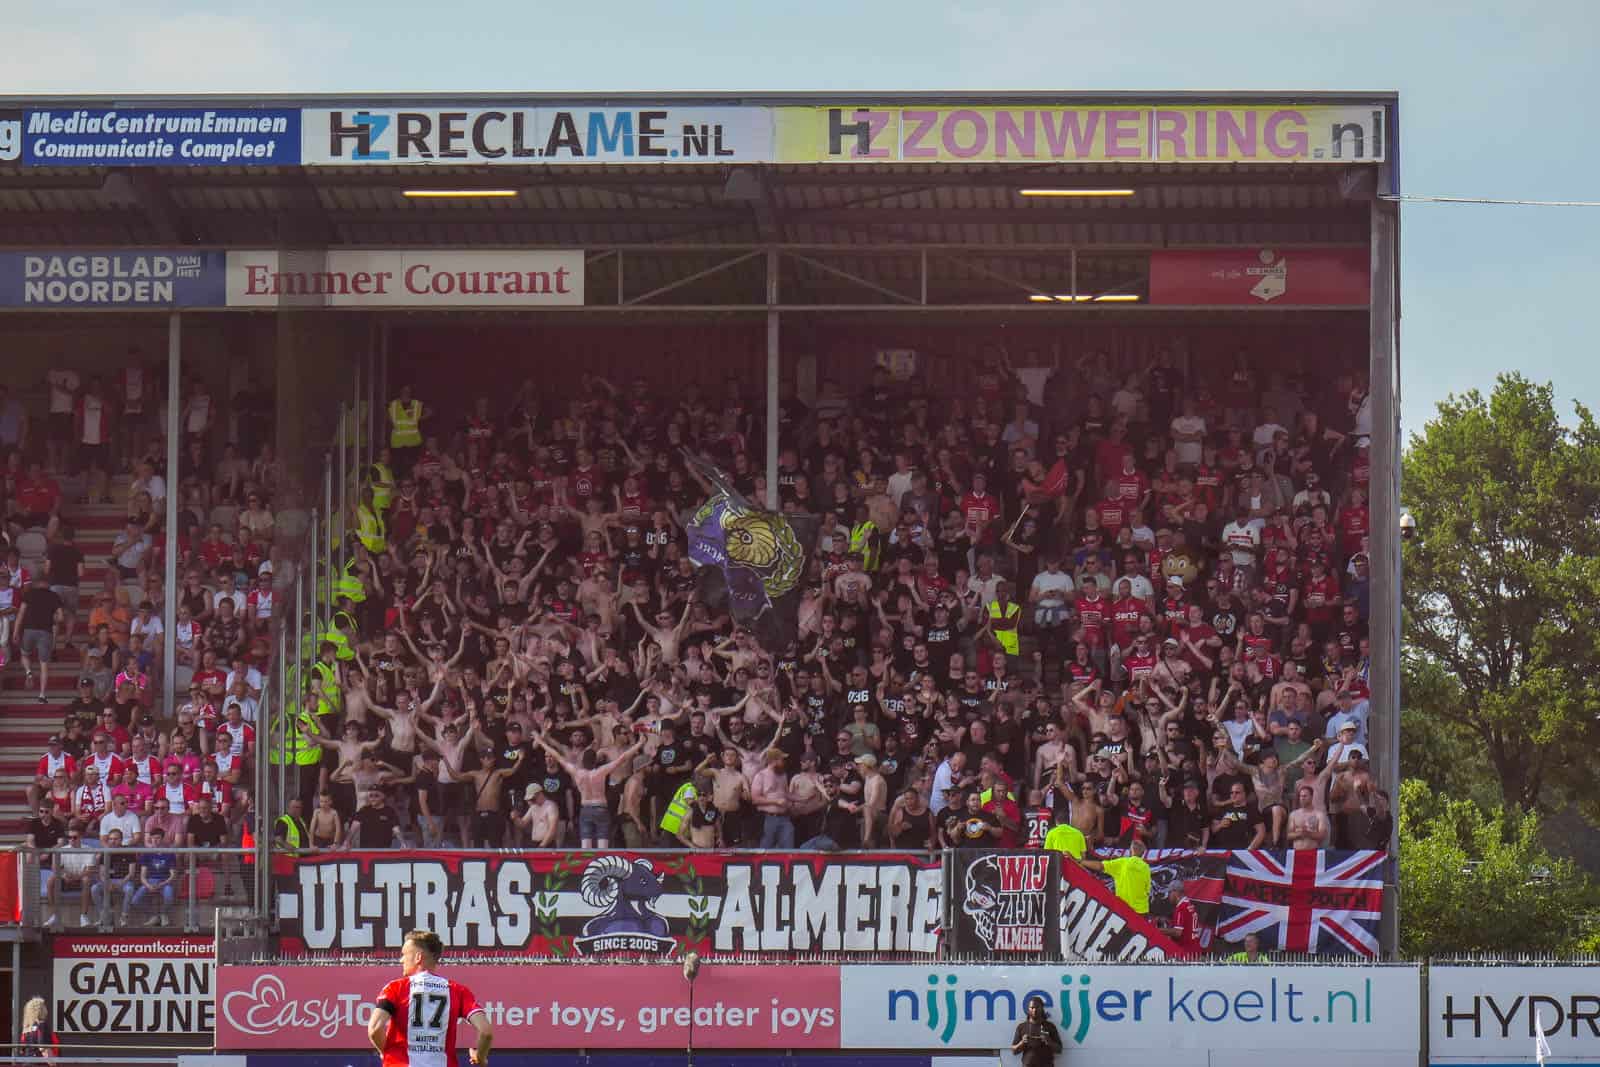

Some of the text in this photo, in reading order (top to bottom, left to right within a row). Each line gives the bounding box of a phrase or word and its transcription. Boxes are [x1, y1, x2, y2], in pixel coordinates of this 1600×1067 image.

[28, 111, 287, 134] MediaCentrumEmmen
[33, 138, 276, 162] Communicatie Compleet
[25, 256, 173, 277] DAGBLAD
[245, 264, 570, 295] Emmer Courant
[25, 281, 173, 301] NOORDEN
[646, 531, 668, 545] 06
[848, 690, 869, 704] 036
[1028, 819, 1049, 839] 26
[996, 855, 1050, 893] WIJ
[299, 861, 531, 948] ULTRAS
[715, 864, 943, 952] ALMERE
[996, 892, 1047, 927] ZIJN
[594, 938, 658, 952] SINCE 2005
[994, 926, 1044, 950] ALMERE
[70, 962, 215, 995] GARAN
[411, 992, 448, 1028] 17
[1169, 977, 1371, 1023] koelt.nl
[550, 1001, 626, 1034] toys,
[638, 1002, 760, 1033] greater
[770, 998, 836, 1034] joys
